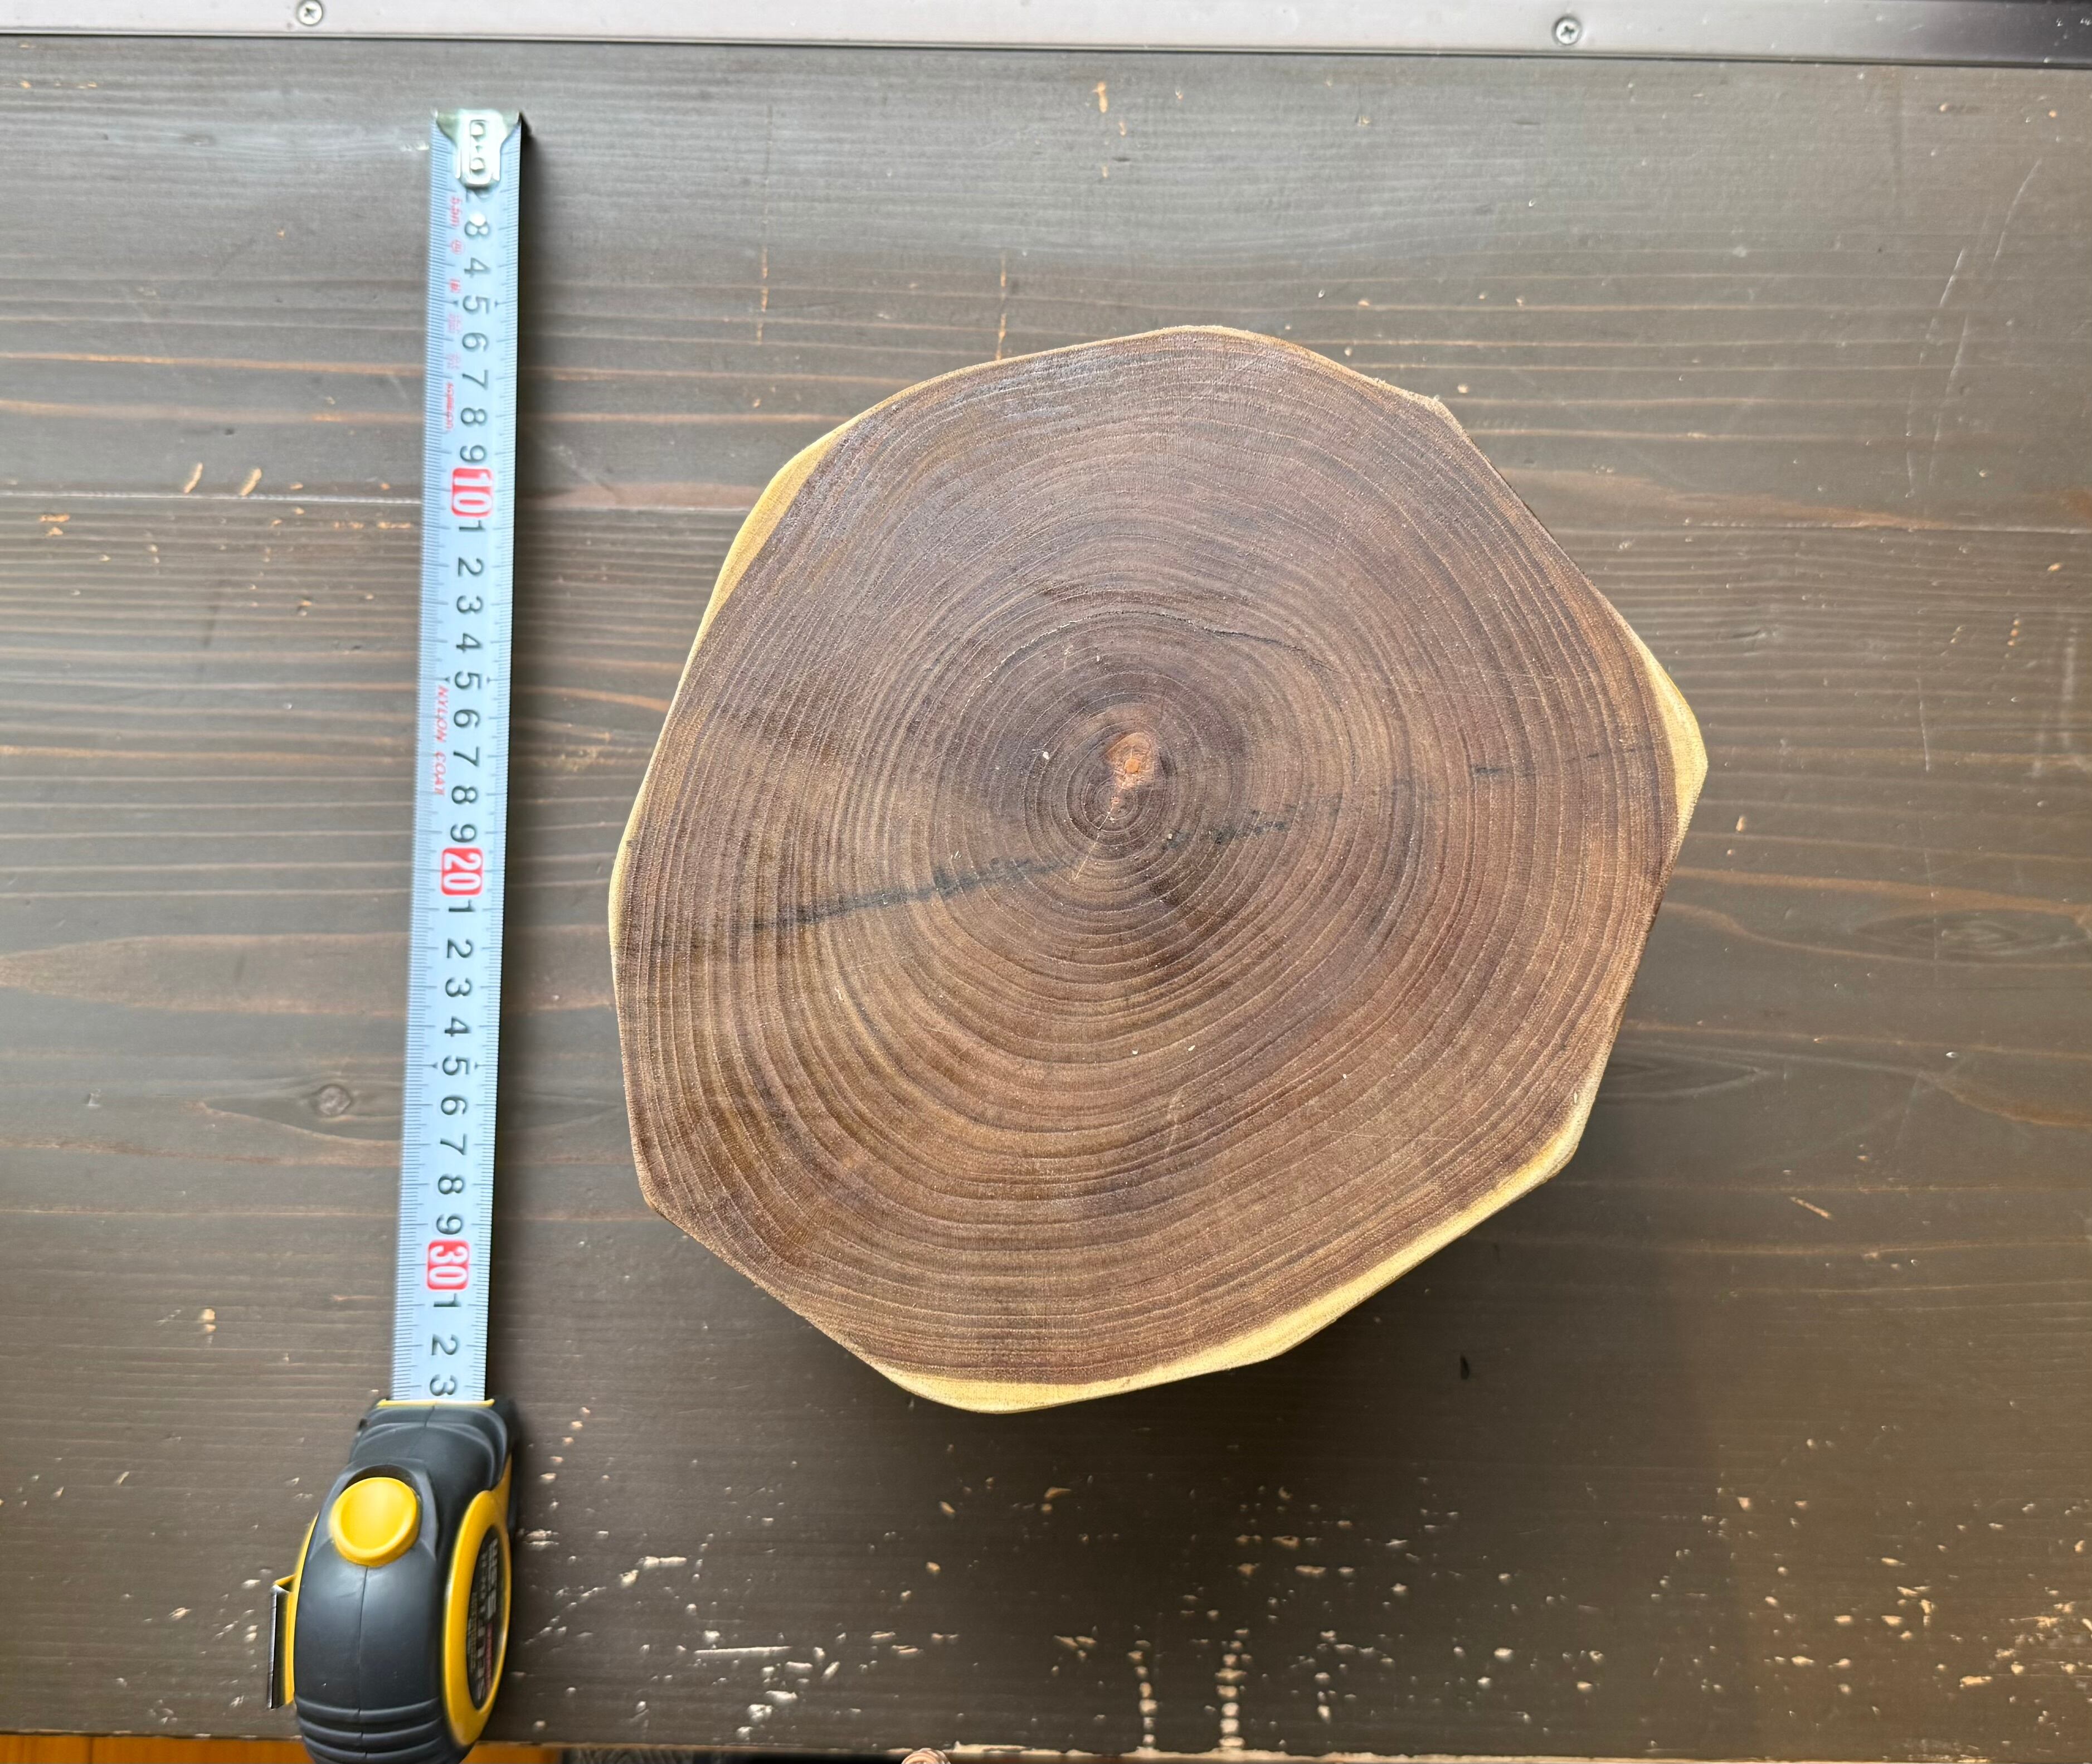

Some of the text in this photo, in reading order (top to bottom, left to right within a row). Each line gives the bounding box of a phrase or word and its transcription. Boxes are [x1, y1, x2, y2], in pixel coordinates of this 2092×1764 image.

[464, 257, 491, 278] 4
[463, 295, 489, 314] 5
[462, 332, 489, 352] 6
[462, 370, 489, 391] 7
[460, 407, 488, 426] 8
[460, 445, 487, 463] 9
[453, 472, 491, 513] 10
[459, 520, 485, 532] 1
[458, 557, 485, 577] 2
[456, 595, 484, 614] 3
[456, 633, 483, 653] 4
[455, 671, 481, 689] 5
[454, 709, 480, 728] 6
[434, 685, 449, 795] NYLON COAT
[453, 746, 480, 767] 7
[451, 785, 478, 804] 8
[450, 824, 477, 843] 9
[443, 852, 482, 891] 20
[449, 899, 475, 912] 1
[447, 938, 473, 959] 2
[445, 977, 472, 997] 3
[444, 1016, 471, 1037] 4
[442, 1055, 470, 1076] 5
[441, 1095, 468, 1115] 6
[440, 1133, 467, 1155] 7
[437, 1174, 465, 1194] 8
[436, 1214, 463, 1235] 9
[429, 1245, 468, 1285] 30
[433, 1293, 461, 1307] 1
[431, 1334, 460, 1355] 2
[430, 1374, 458, 1396] 3
